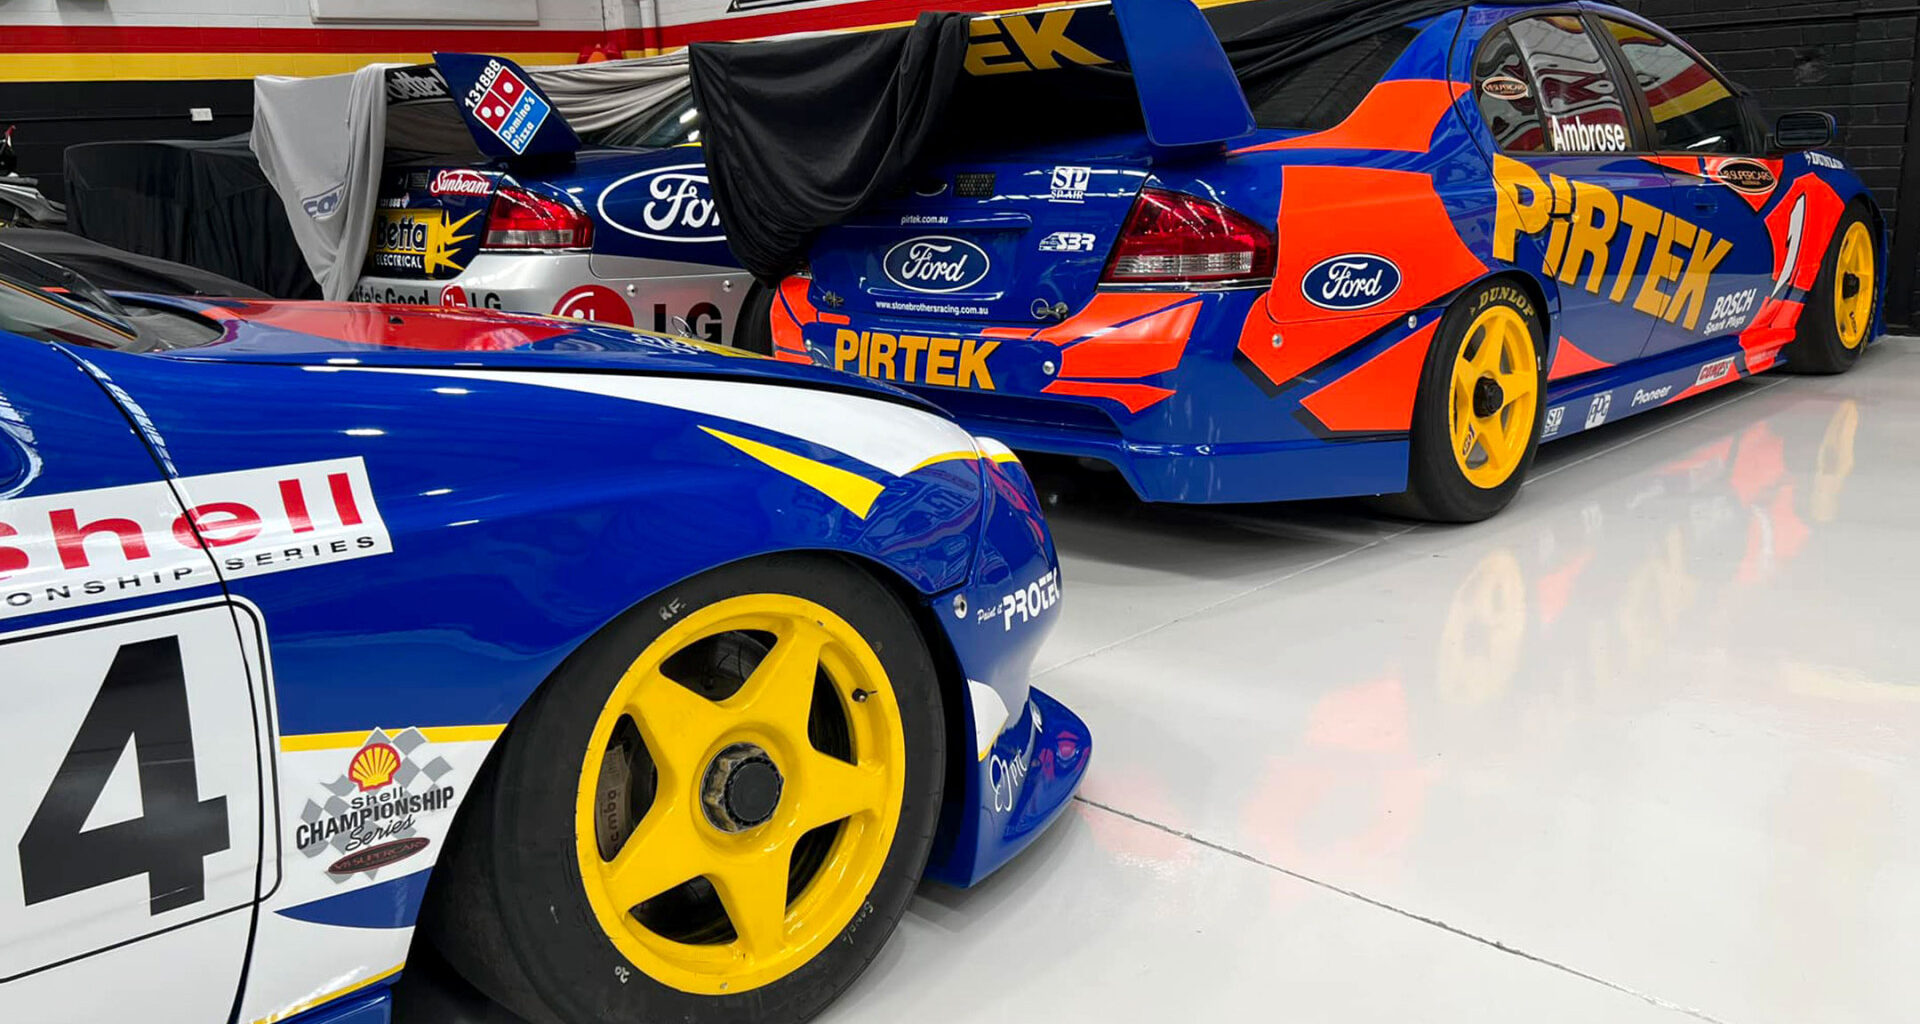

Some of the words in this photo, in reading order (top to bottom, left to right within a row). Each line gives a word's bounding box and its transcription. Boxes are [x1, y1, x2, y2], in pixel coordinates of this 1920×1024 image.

[963, 10, 1113, 76] EK
[464, 58, 502, 109] 131888
[501, 95, 536, 142] Domino's
[511, 121, 535, 150] Pizza
[1551, 114, 1626, 152] Ambrose
[430, 169, 495, 195] Sunbeam
[1053, 167, 1088, 189] SP
[901, 215, 949, 226] pirtek.com.au
[376, 254, 423, 269] ELECTRICAL
[901, 242, 969, 282] Ford
[1772, 194, 1806, 298] 1
[1322, 262, 1384, 300] Ford
[875, 300, 989, 315] www.stonebrothersracing.com.au
[1478, 286, 1535, 317] DUNLOP
[1710, 287, 1757, 321] BOSCH
[834, 328, 1001, 390] PIRTEK
[1631, 385, 1673, 408] Pioneer
[6, 566, 193, 607] ONSHIP
[224, 535, 376, 571] SERIES
[18, 635, 231, 917] 4
[351, 786, 404, 810] Shell
[295, 785, 455, 851] CHAMPIONSHIP
[345, 813, 416, 851] Series
